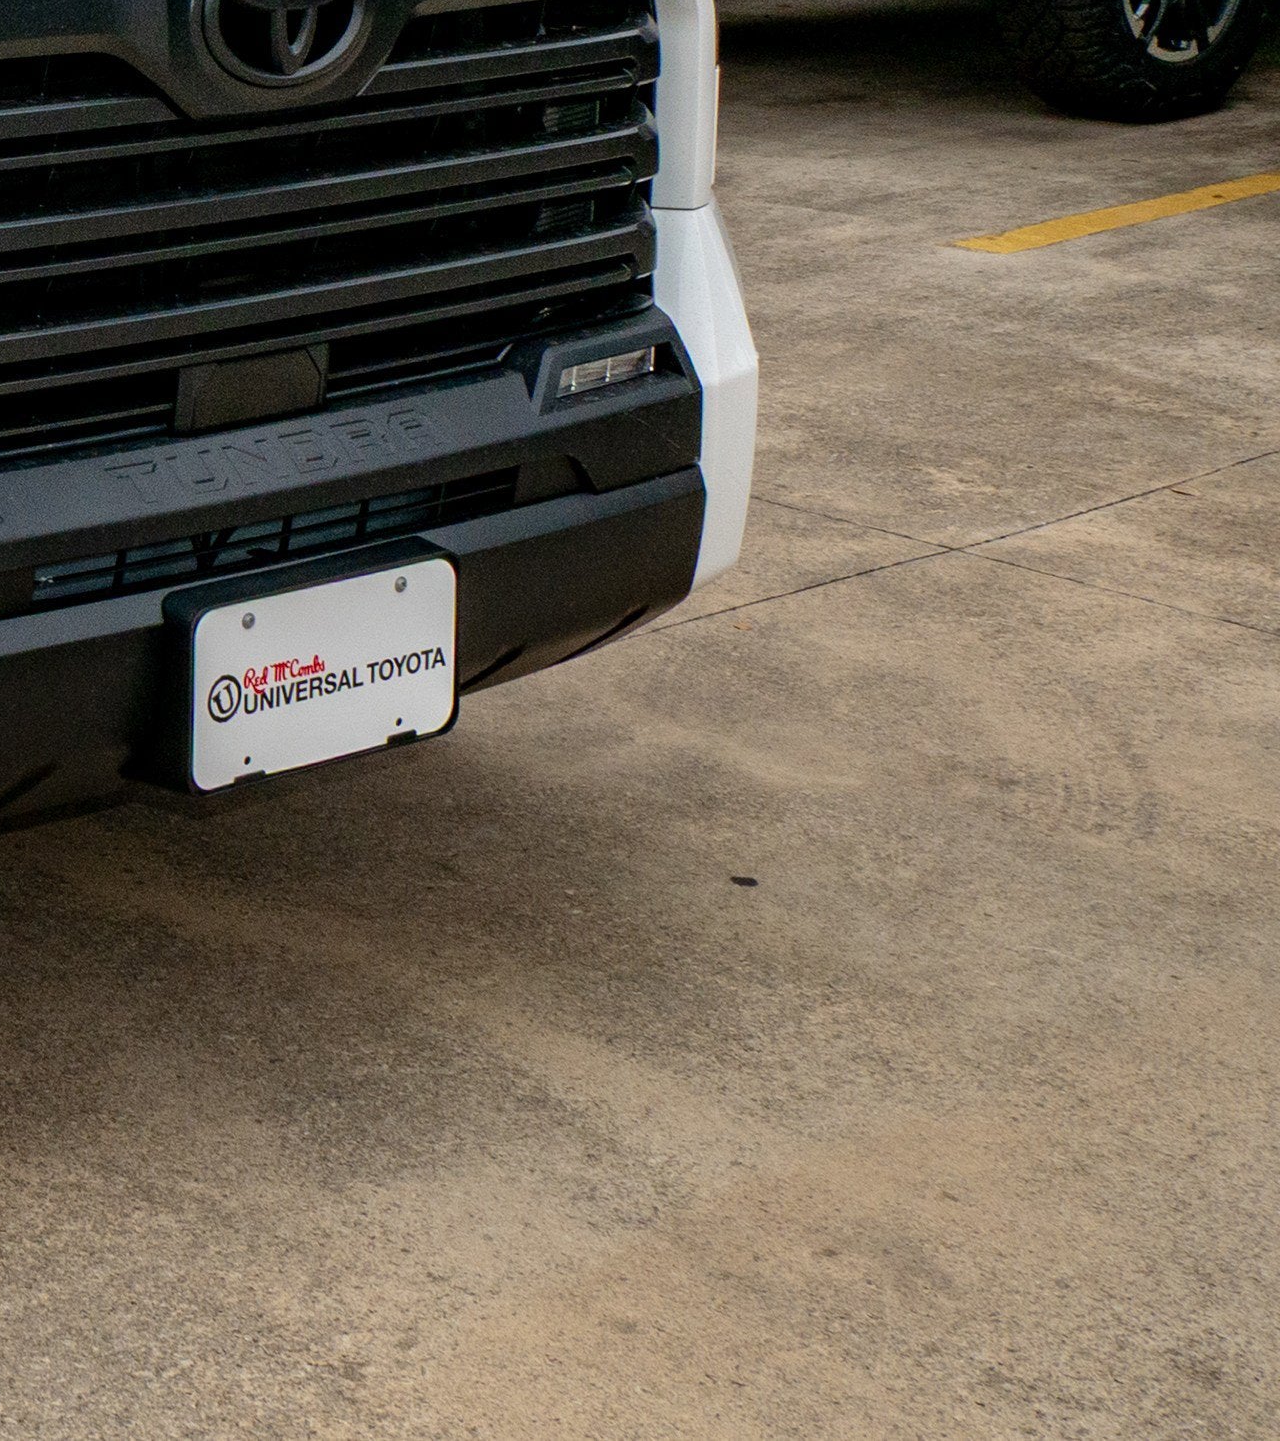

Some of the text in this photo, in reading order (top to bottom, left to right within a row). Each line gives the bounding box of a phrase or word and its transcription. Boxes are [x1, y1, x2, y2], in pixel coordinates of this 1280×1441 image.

[104, 409, 440, 505] TUNDRA
[244, 655, 326, 695] Red McCombs
[244, 647, 446, 714] UNIVERSAL TOYOTA
